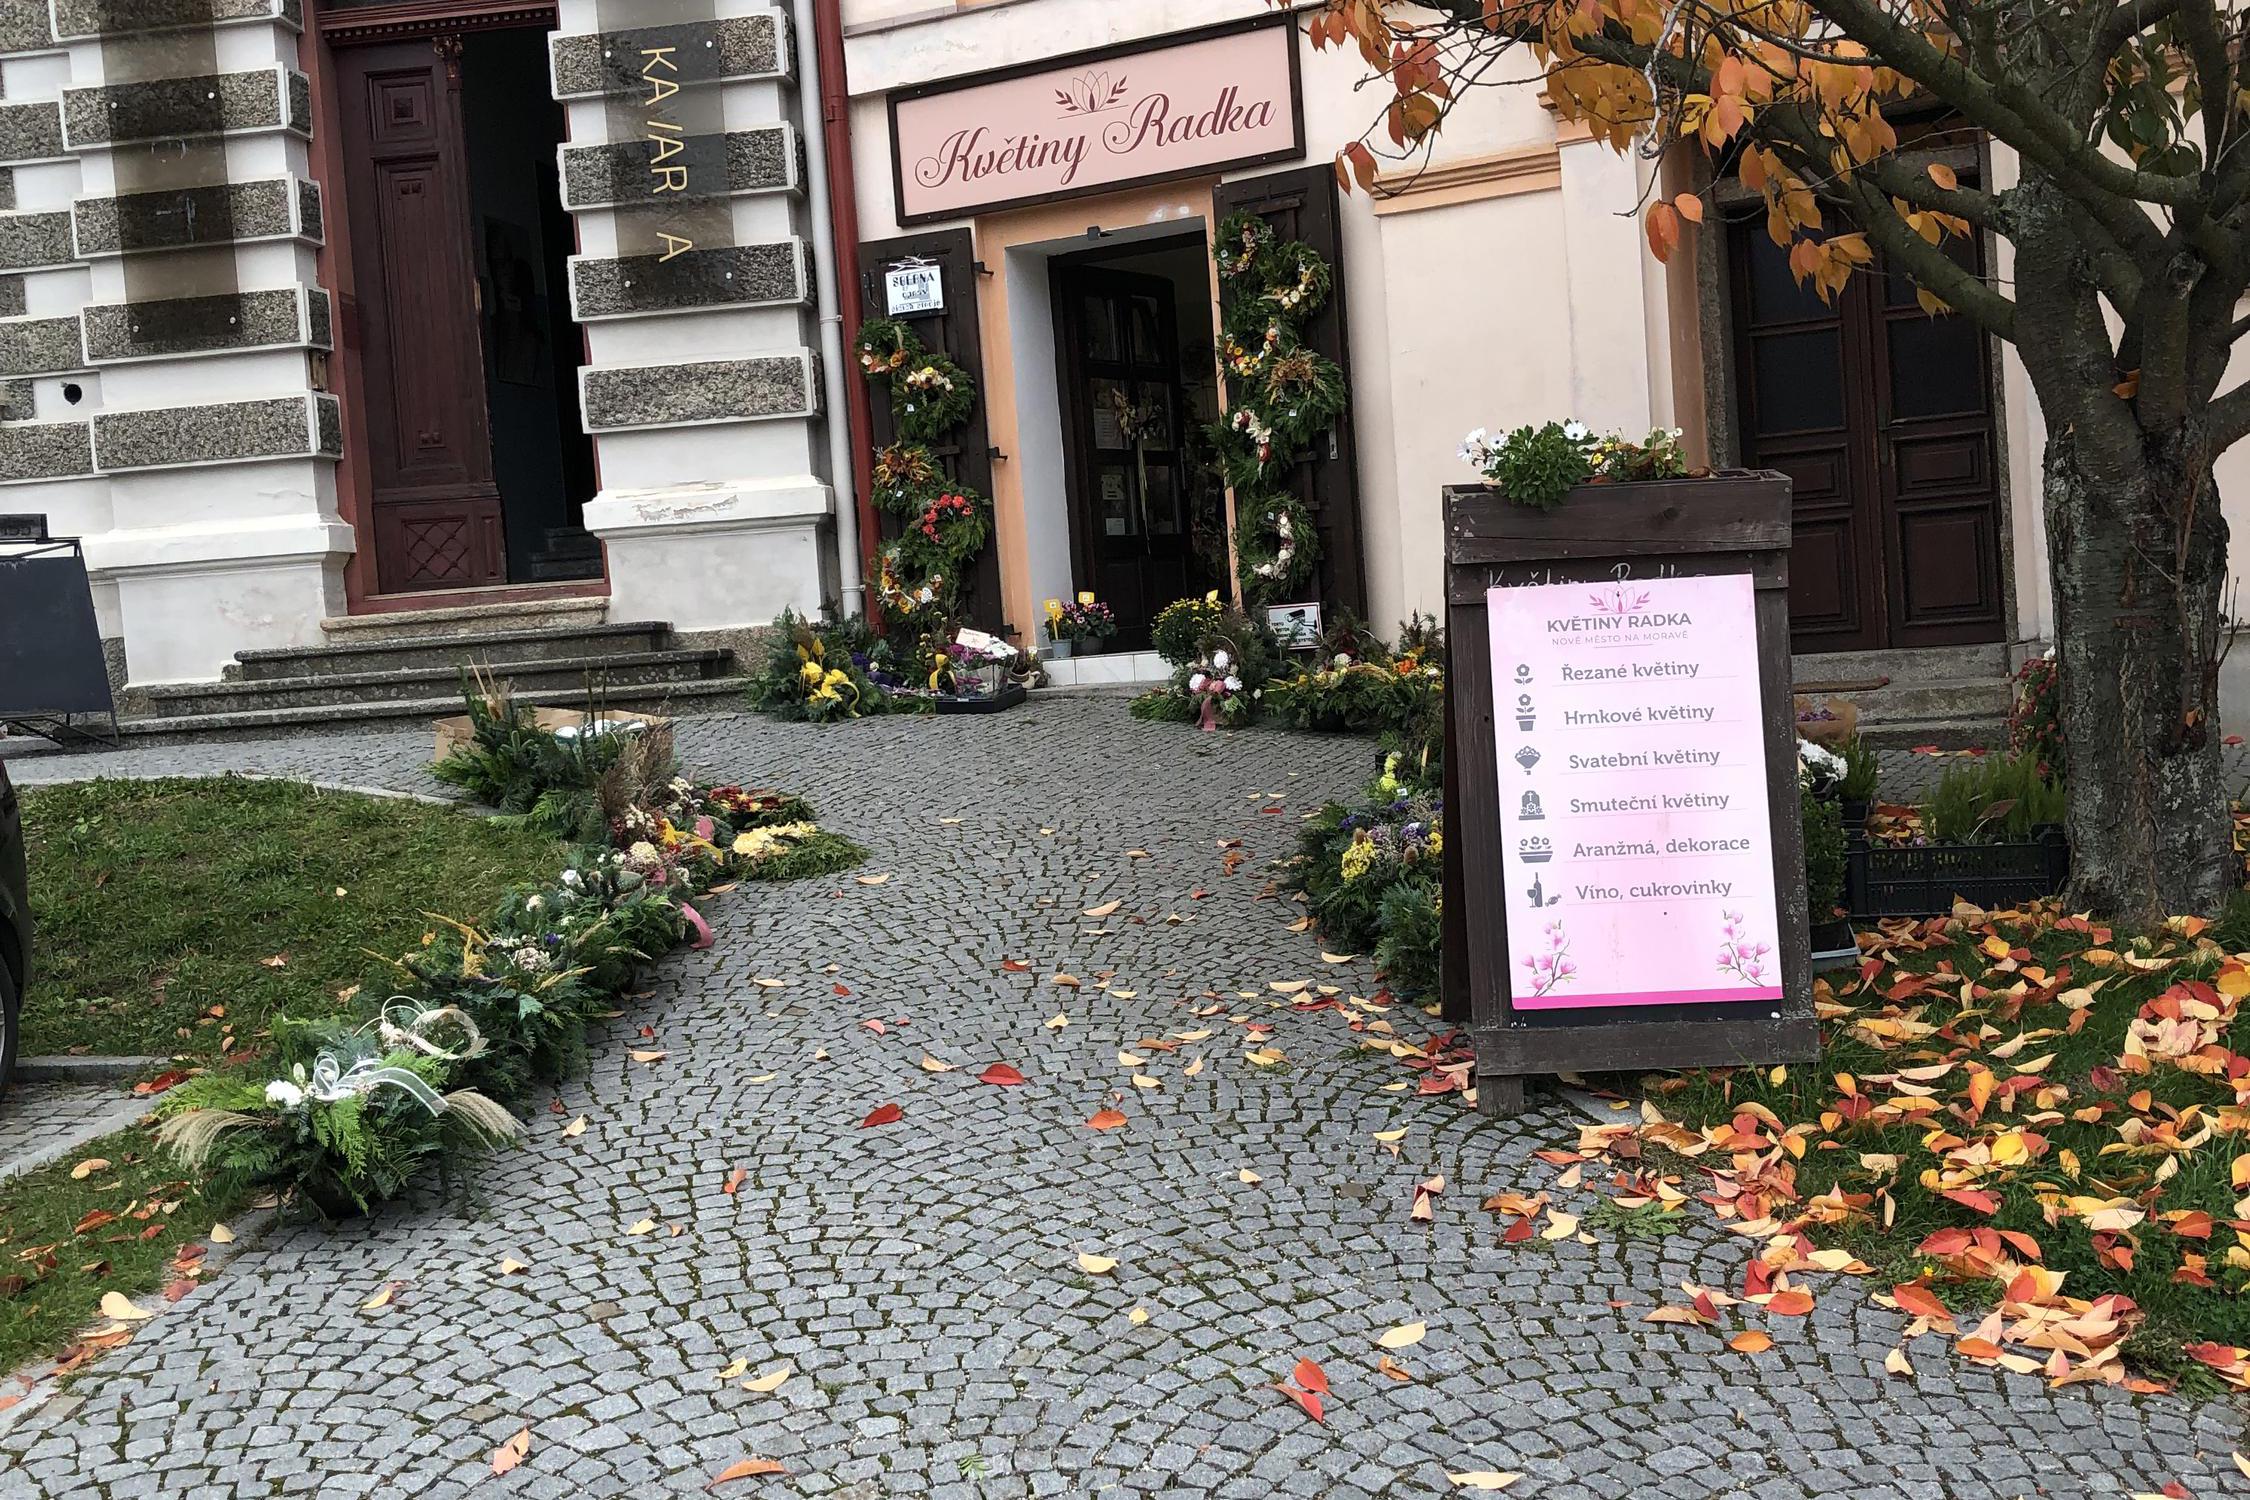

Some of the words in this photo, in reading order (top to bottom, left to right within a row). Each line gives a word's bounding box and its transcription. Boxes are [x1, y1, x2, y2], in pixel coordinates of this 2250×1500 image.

[914, 126, 1092, 188] Květiny
[1102, 85, 1277, 155] Radka
[1547, 616, 1623, 633] KVĚTINY
[1628, 612, 1692, 628] RADKA
[1552, 636, 1581, 646] NOVÉ
[1585, 634, 1621, 644] MĚSTO
[1625, 633, 1640, 642] NA
[1562, 664, 1628, 681] Řezané
[1632, 661, 1700, 678] květiny
[1564, 707, 1643, 725] Hrnkové
[1647, 705, 1715, 722] květiny
[1569, 751, 1649, 769] Svatební
[1653, 749, 1721, 766] květiny
[1570, 795, 1658, 814] Smuteční
[1662, 793, 1730, 810] květiny
[1573, 840, 1660, 858] Aranžmá,
[1665, 837, 1750, 854] dekorace
[1575, 884, 1624, 900] Víno,
[1629, 880, 1732, 898] cukrovinky
